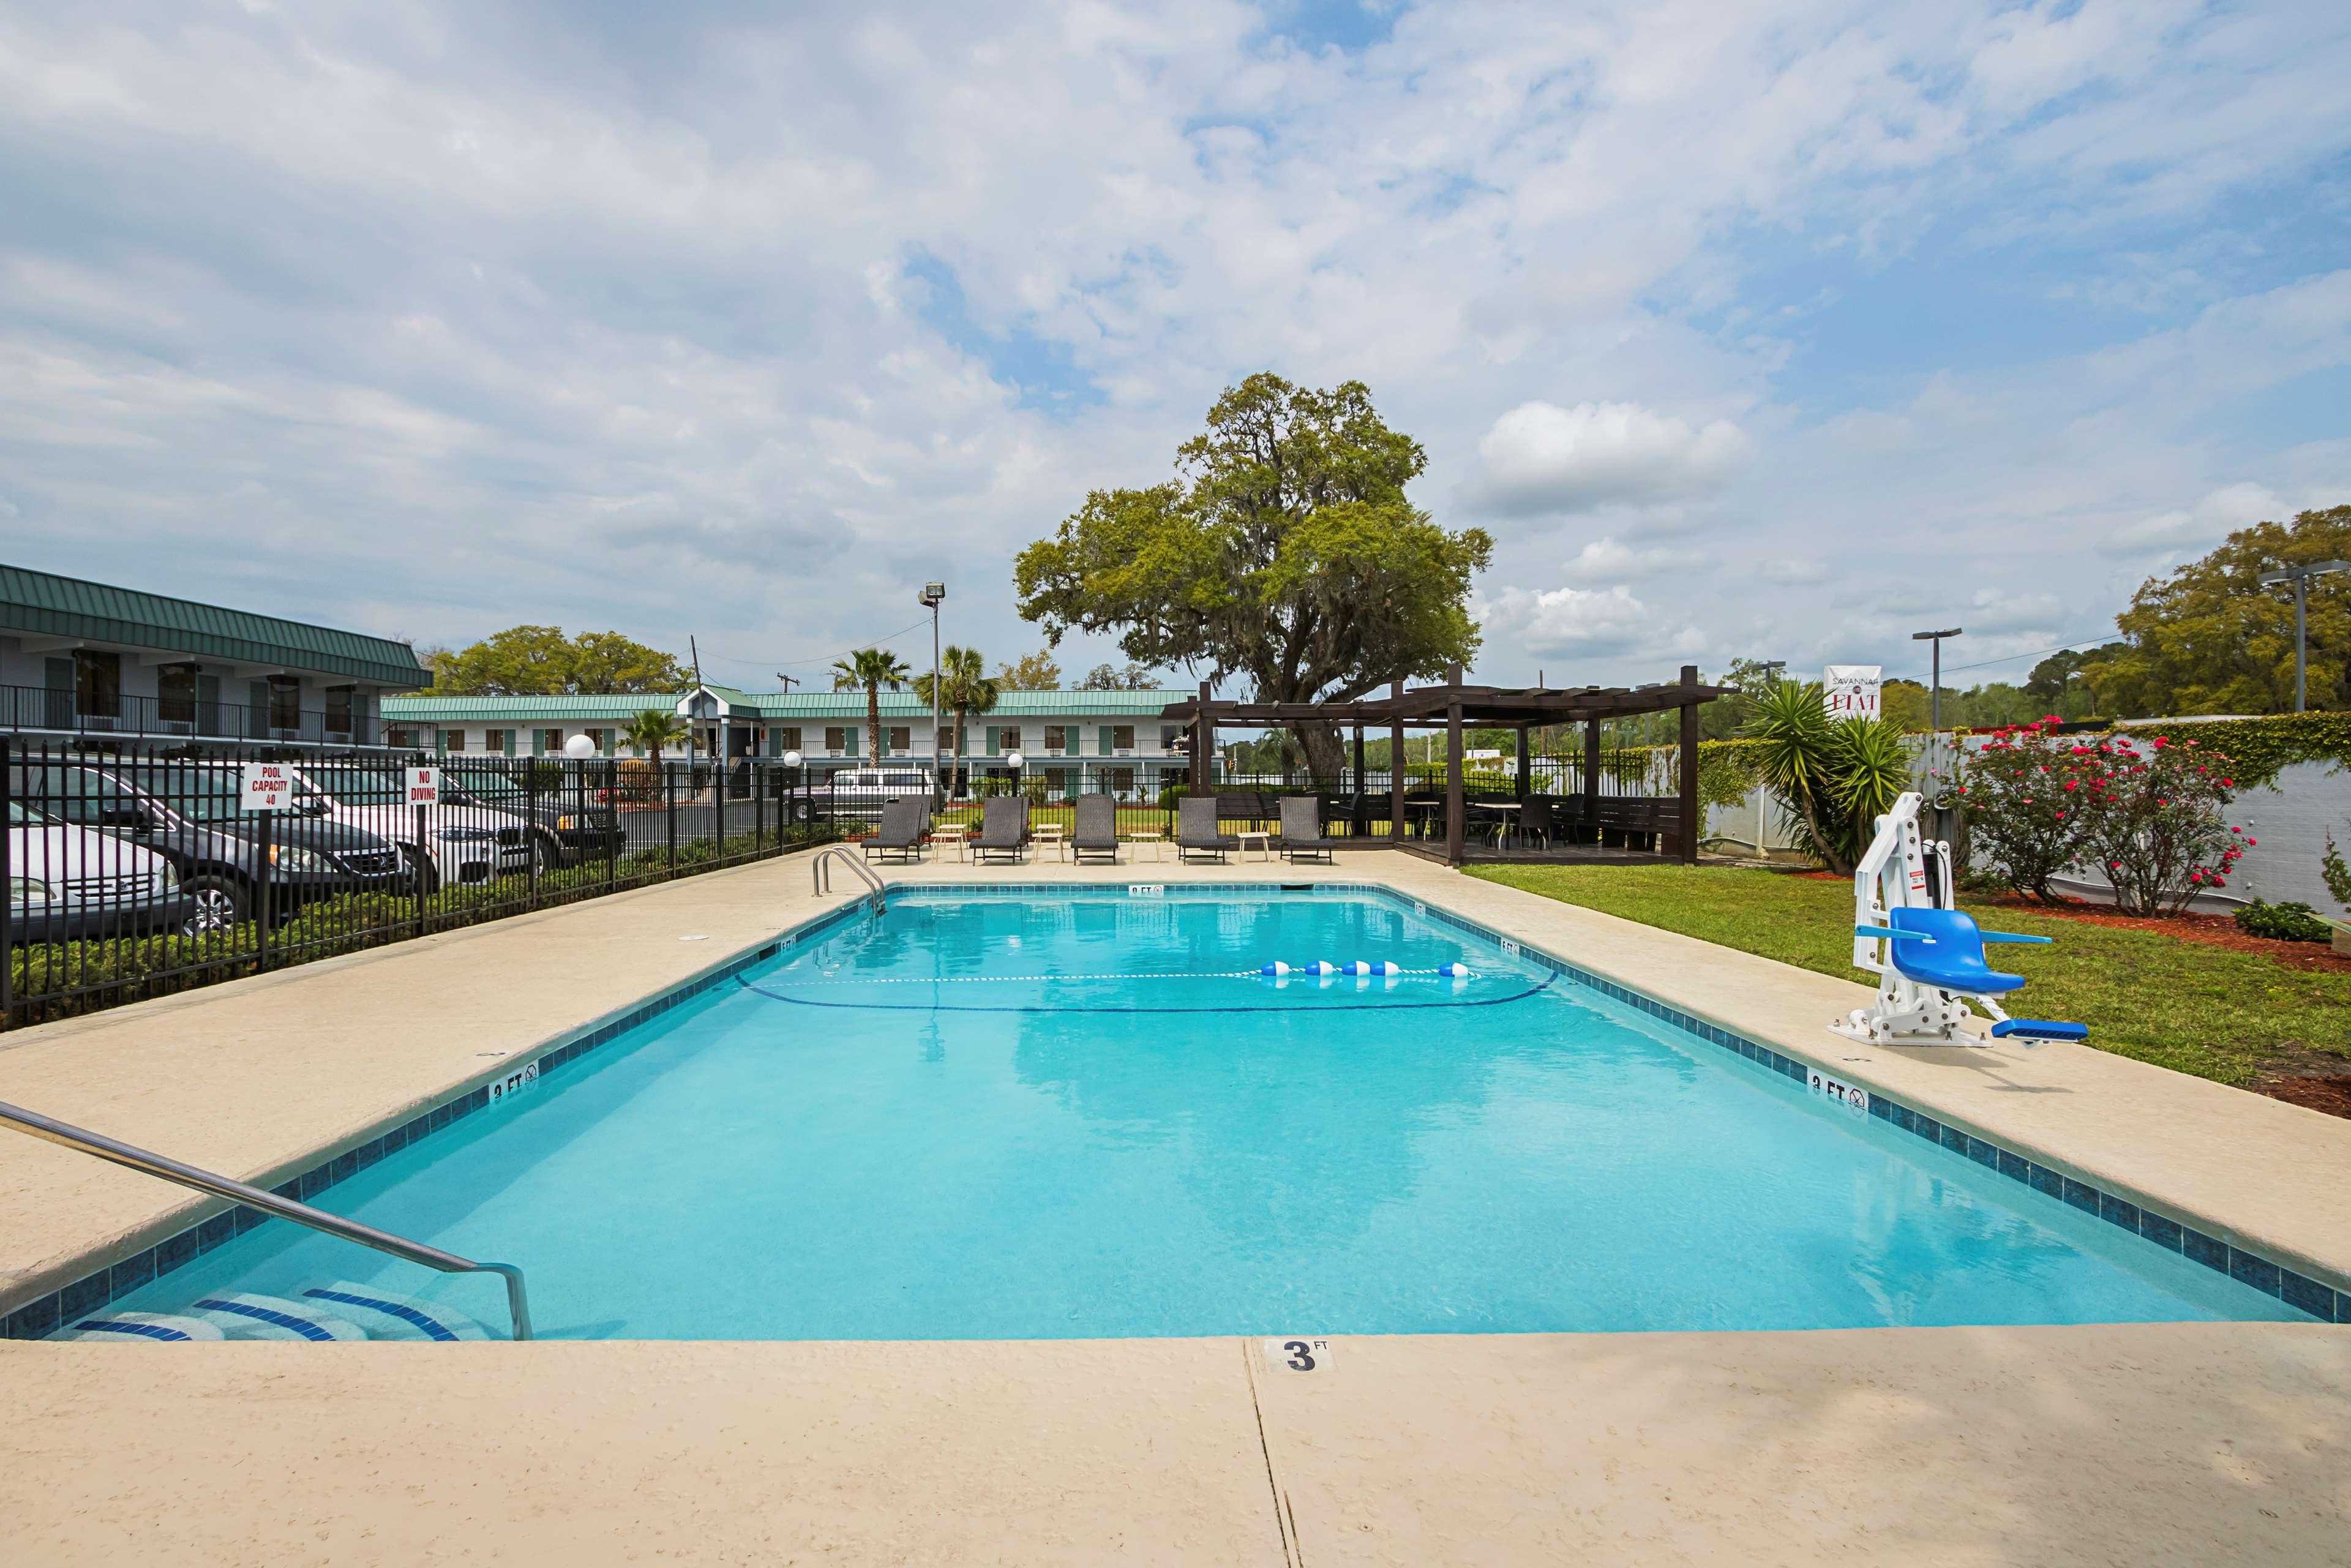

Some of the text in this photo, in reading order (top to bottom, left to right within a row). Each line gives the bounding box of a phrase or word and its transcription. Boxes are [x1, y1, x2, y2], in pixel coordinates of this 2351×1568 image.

[1832, 694, 1877, 710] FIAT
[262, 767, 281, 778] POOL
[419, 770, 430, 784] NO
[252, 780, 288, 792] CAPACITY
[266, 794, 276, 805] 40
[411, 787, 436, 801] DIVING
[507, 1073, 522, 1093] FT
[1827, 1080, 1845, 1100] FT
[1284, 1341, 1327, 1371] 3 FT
